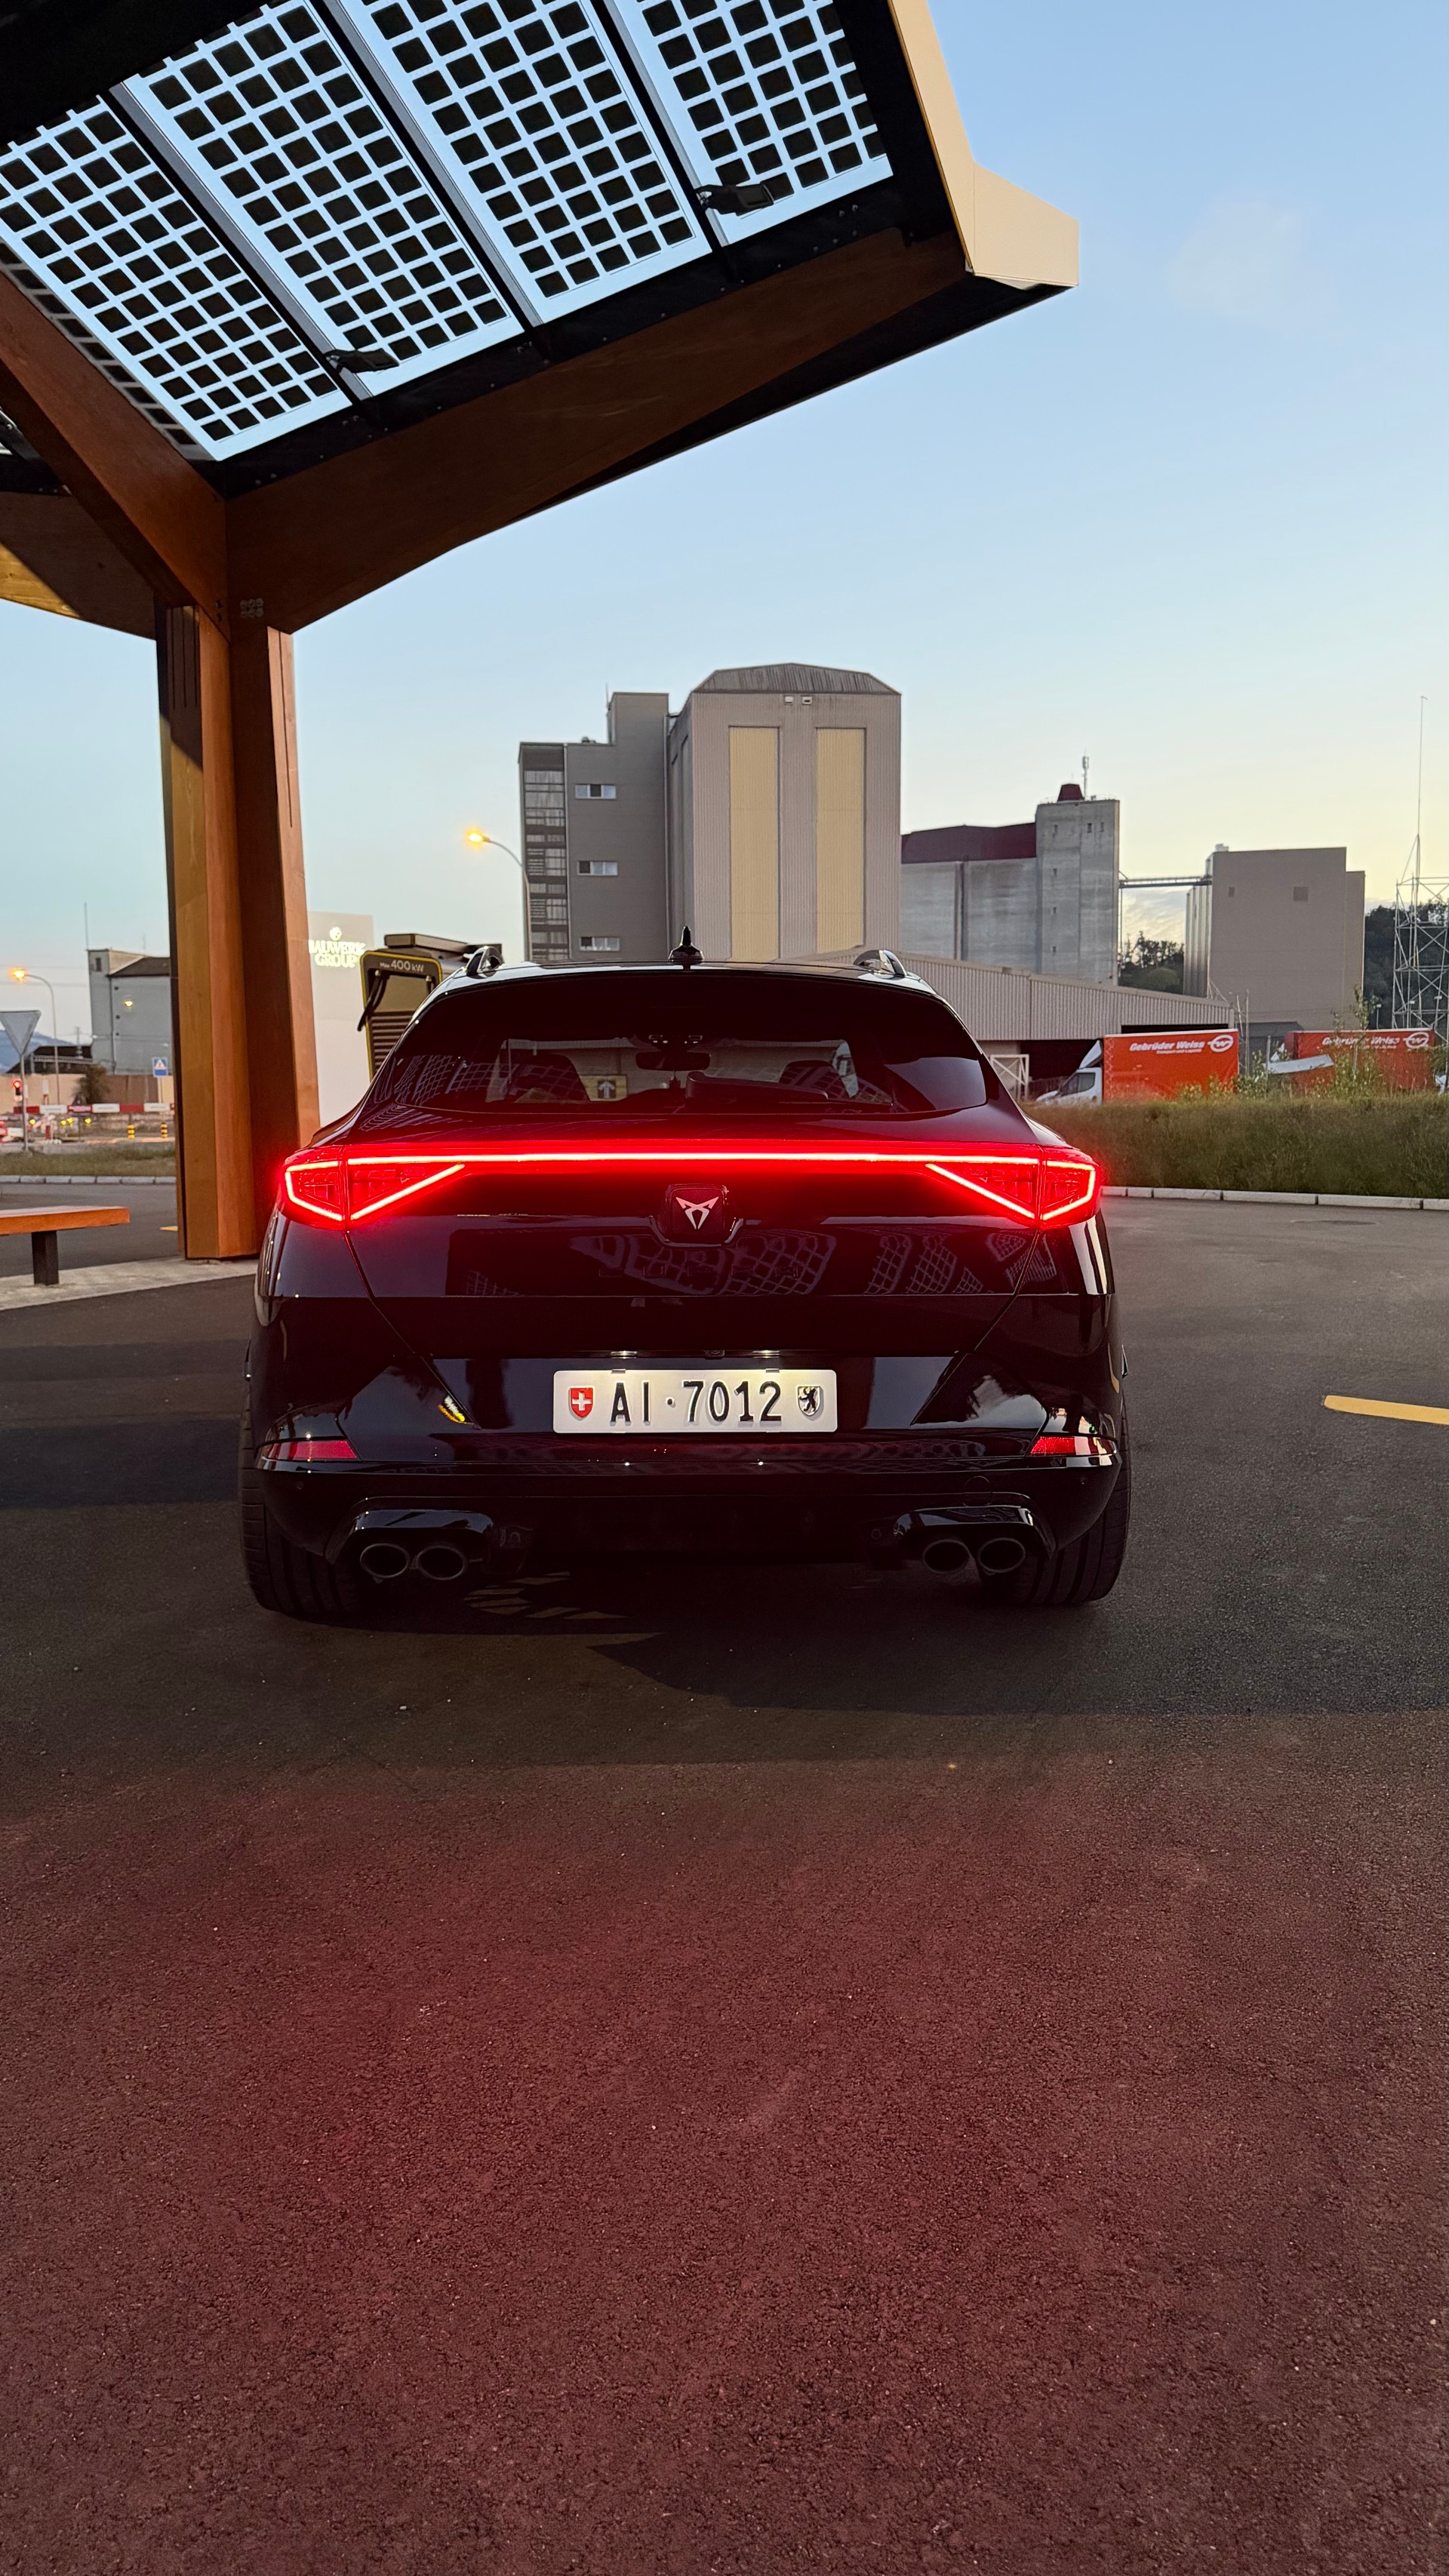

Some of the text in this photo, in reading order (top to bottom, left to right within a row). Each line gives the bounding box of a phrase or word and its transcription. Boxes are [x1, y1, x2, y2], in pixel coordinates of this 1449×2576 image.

[315, 953, 358, 968] GROUP
[391, 959, 411, 971] 400
[411, 963, 424, 972] kW
[1129, 1042, 1174, 1051] Gebrüder
[1176, 1040, 1205, 1050] Weiss
